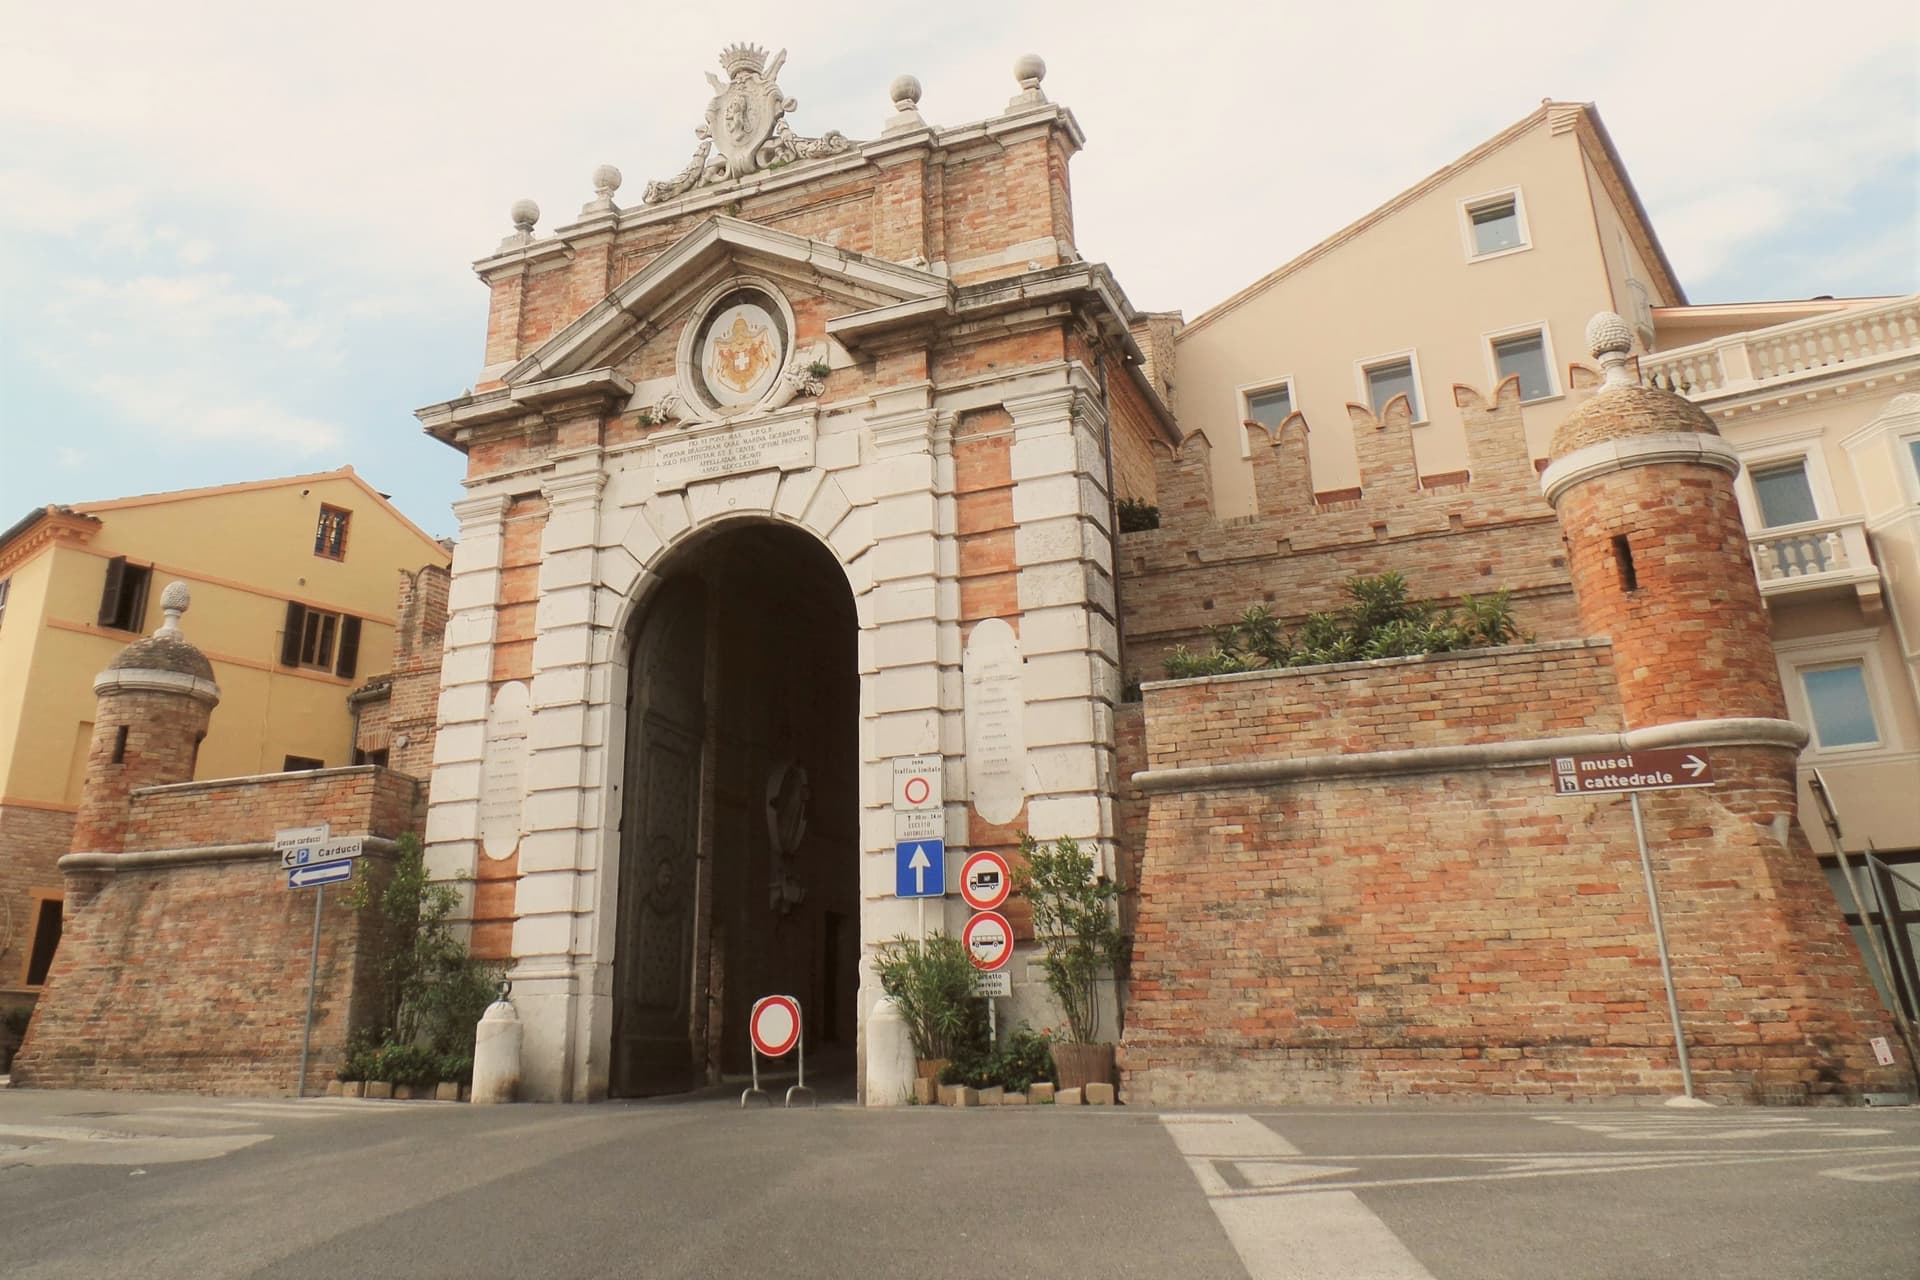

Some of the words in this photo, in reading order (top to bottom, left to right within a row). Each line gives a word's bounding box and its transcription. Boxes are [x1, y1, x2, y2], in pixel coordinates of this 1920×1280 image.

[1580, 755, 1634, 771] musei
[1584, 771, 1673, 789] cattedrale
[318, 843, 360, 857] Carducci
